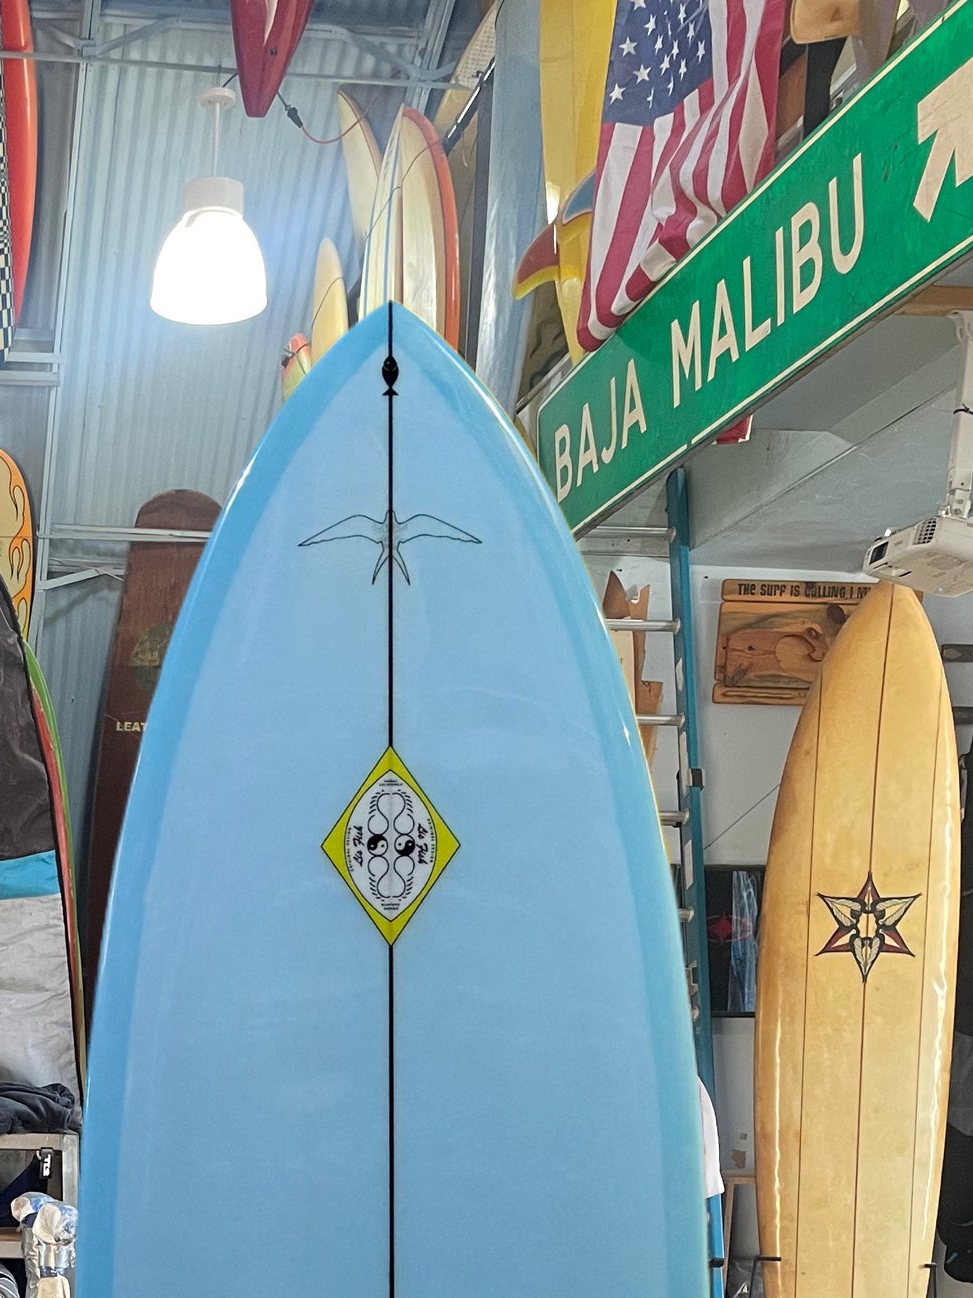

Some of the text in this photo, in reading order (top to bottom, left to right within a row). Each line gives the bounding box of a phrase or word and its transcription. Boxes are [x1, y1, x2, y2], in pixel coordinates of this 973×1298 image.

[554, 152, 865, 501] BAJA MALIBU
[790, 585, 801, 597] IS
